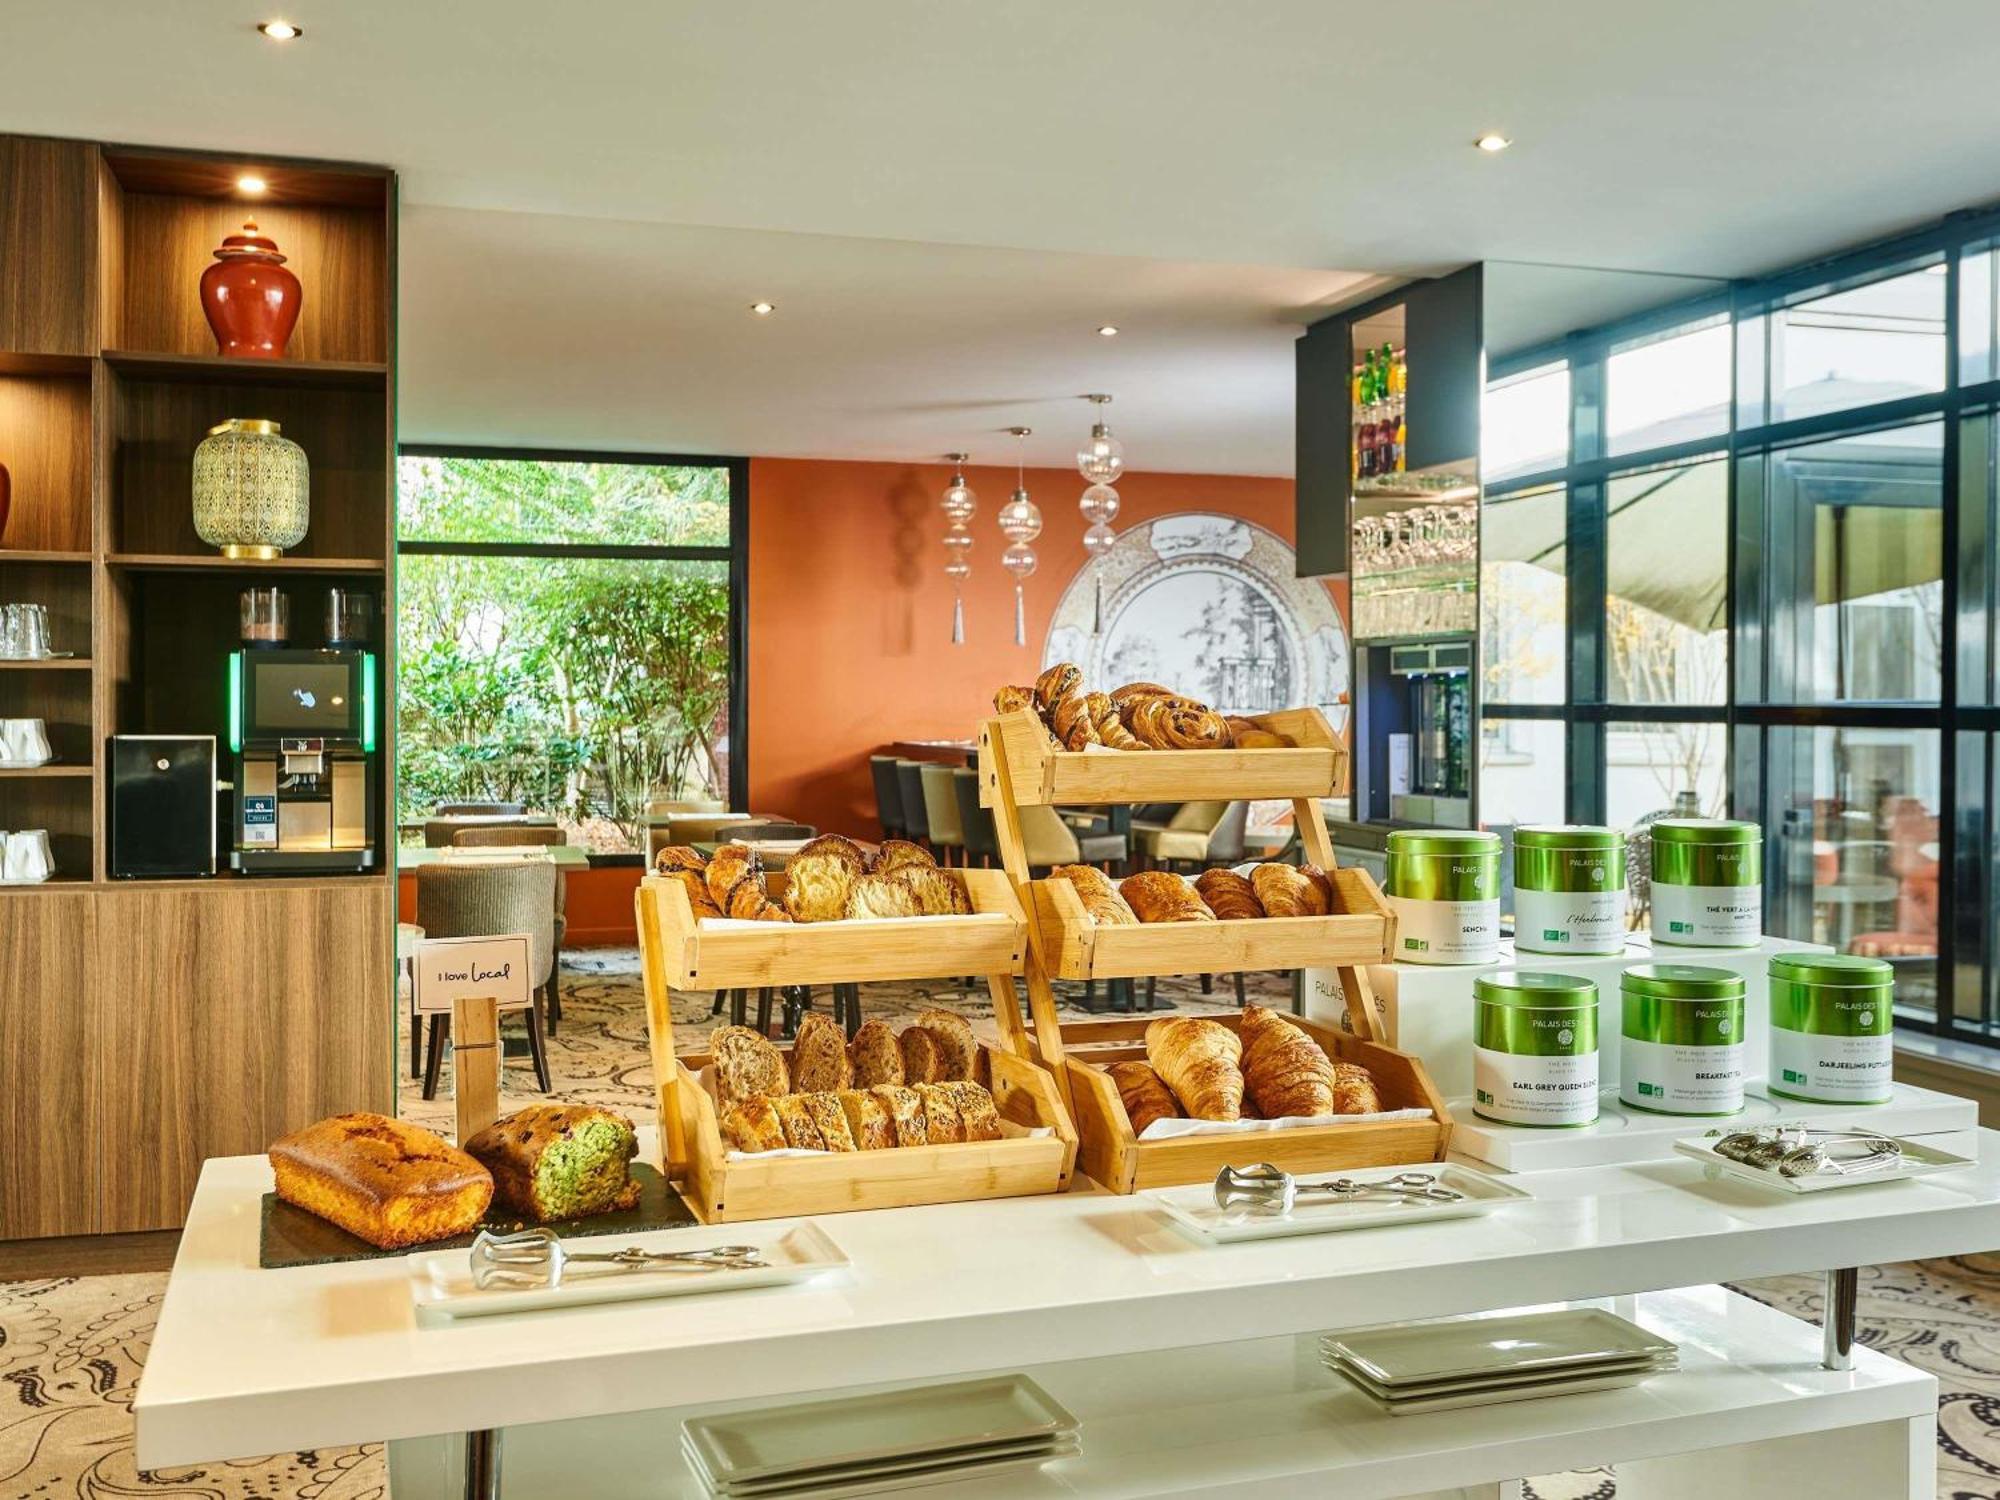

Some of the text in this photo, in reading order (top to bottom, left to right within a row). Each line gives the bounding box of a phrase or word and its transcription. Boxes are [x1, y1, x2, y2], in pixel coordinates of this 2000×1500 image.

[444, 972, 468, 982] love
[1315, 980, 1344, 1001] PALAIS
[1695, 1071, 1733, 1080] BREAKFAST
[1512, 1081, 1534, 1090] EARL
[1535, 1083, 1557, 1091] GREY
